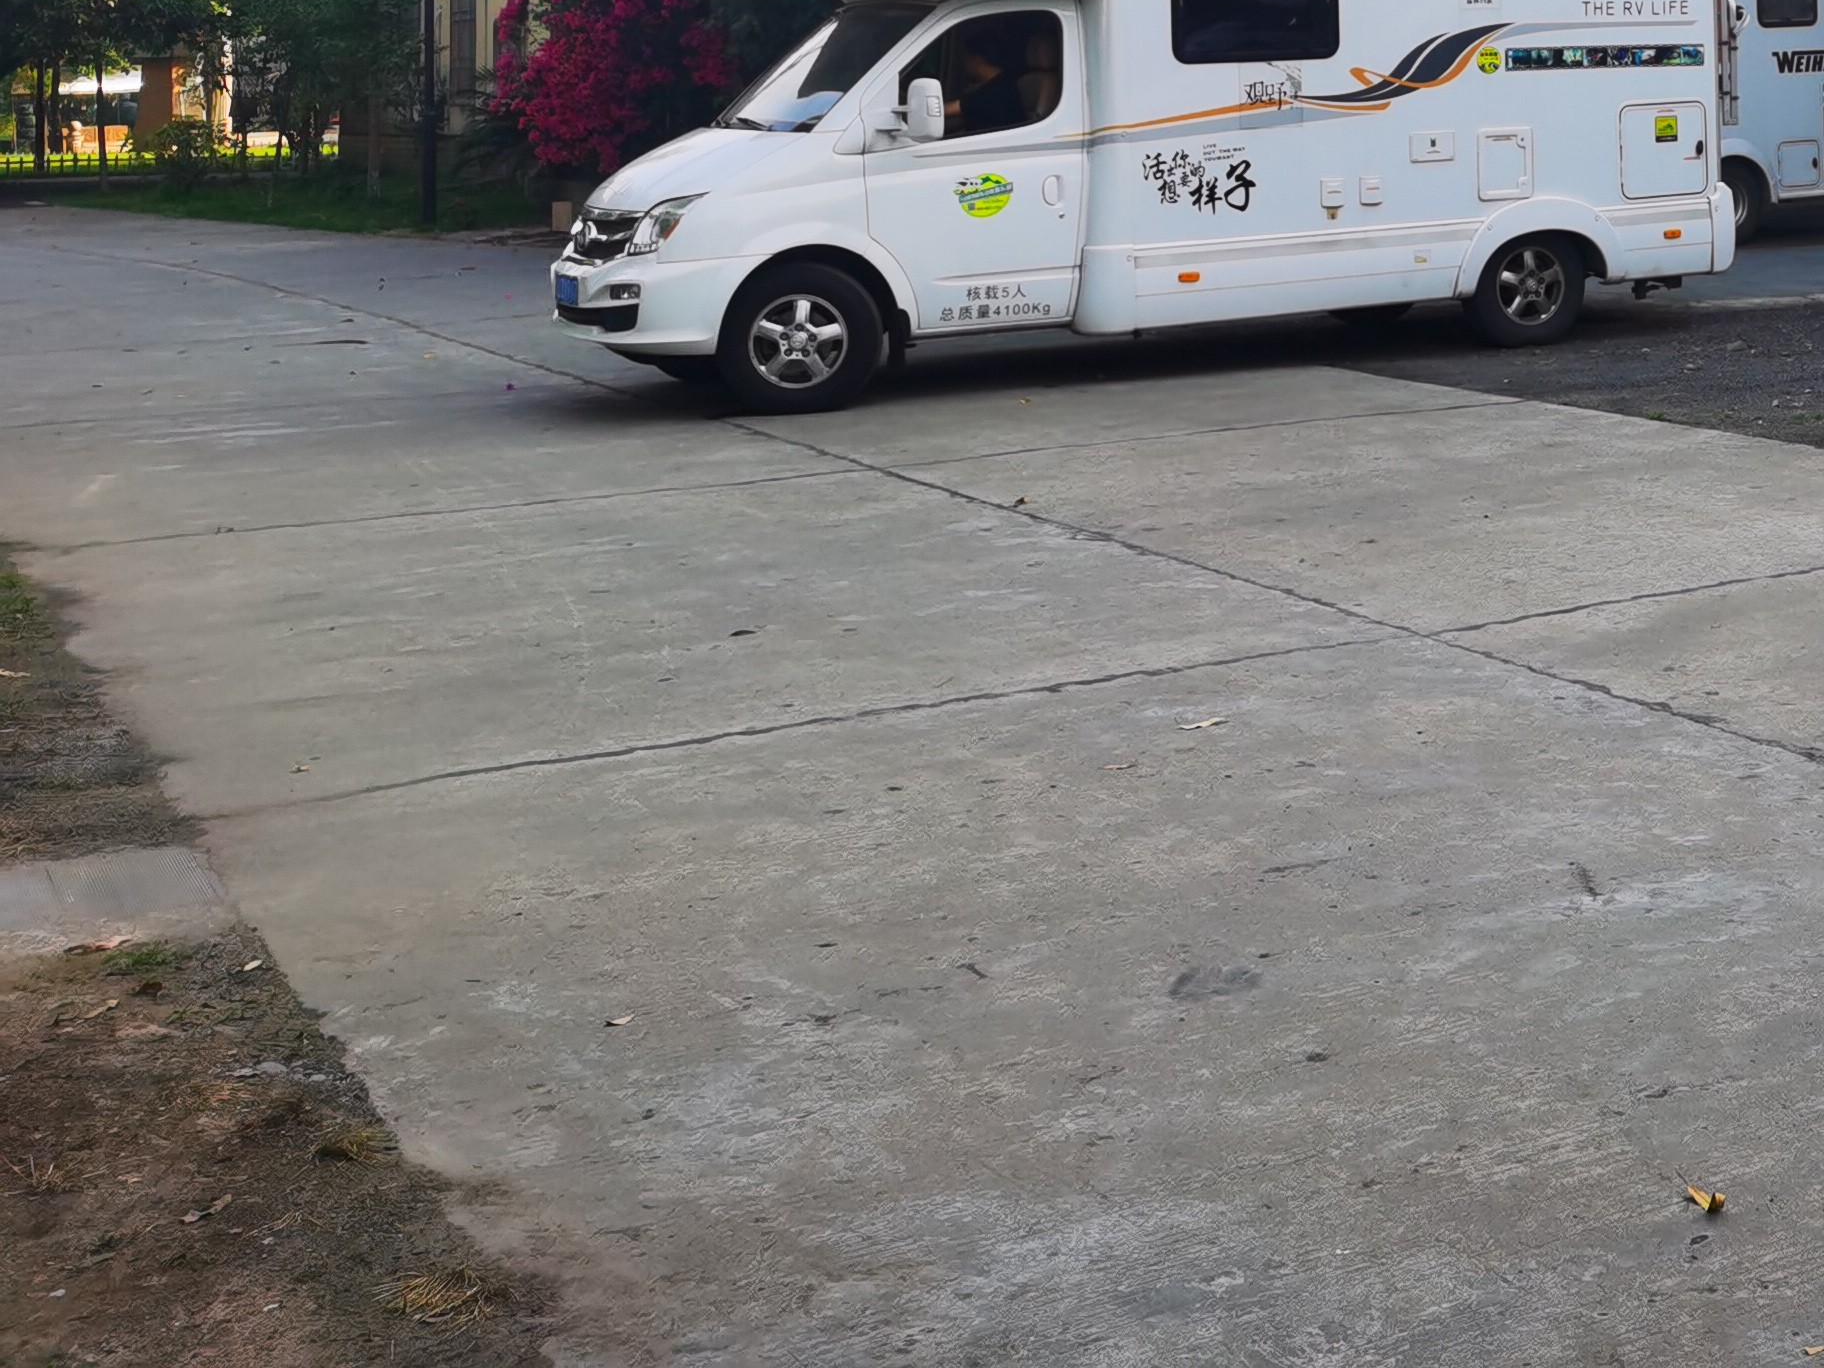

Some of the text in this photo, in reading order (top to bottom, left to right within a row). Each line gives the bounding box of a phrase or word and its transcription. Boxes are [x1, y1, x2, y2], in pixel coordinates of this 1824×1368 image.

[1582, 0, 1689, 16] THE RV LIFE
[966, 284, 1027, 301] 核载5人
[939, 303, 1052, 322] 总质量4100Kg
